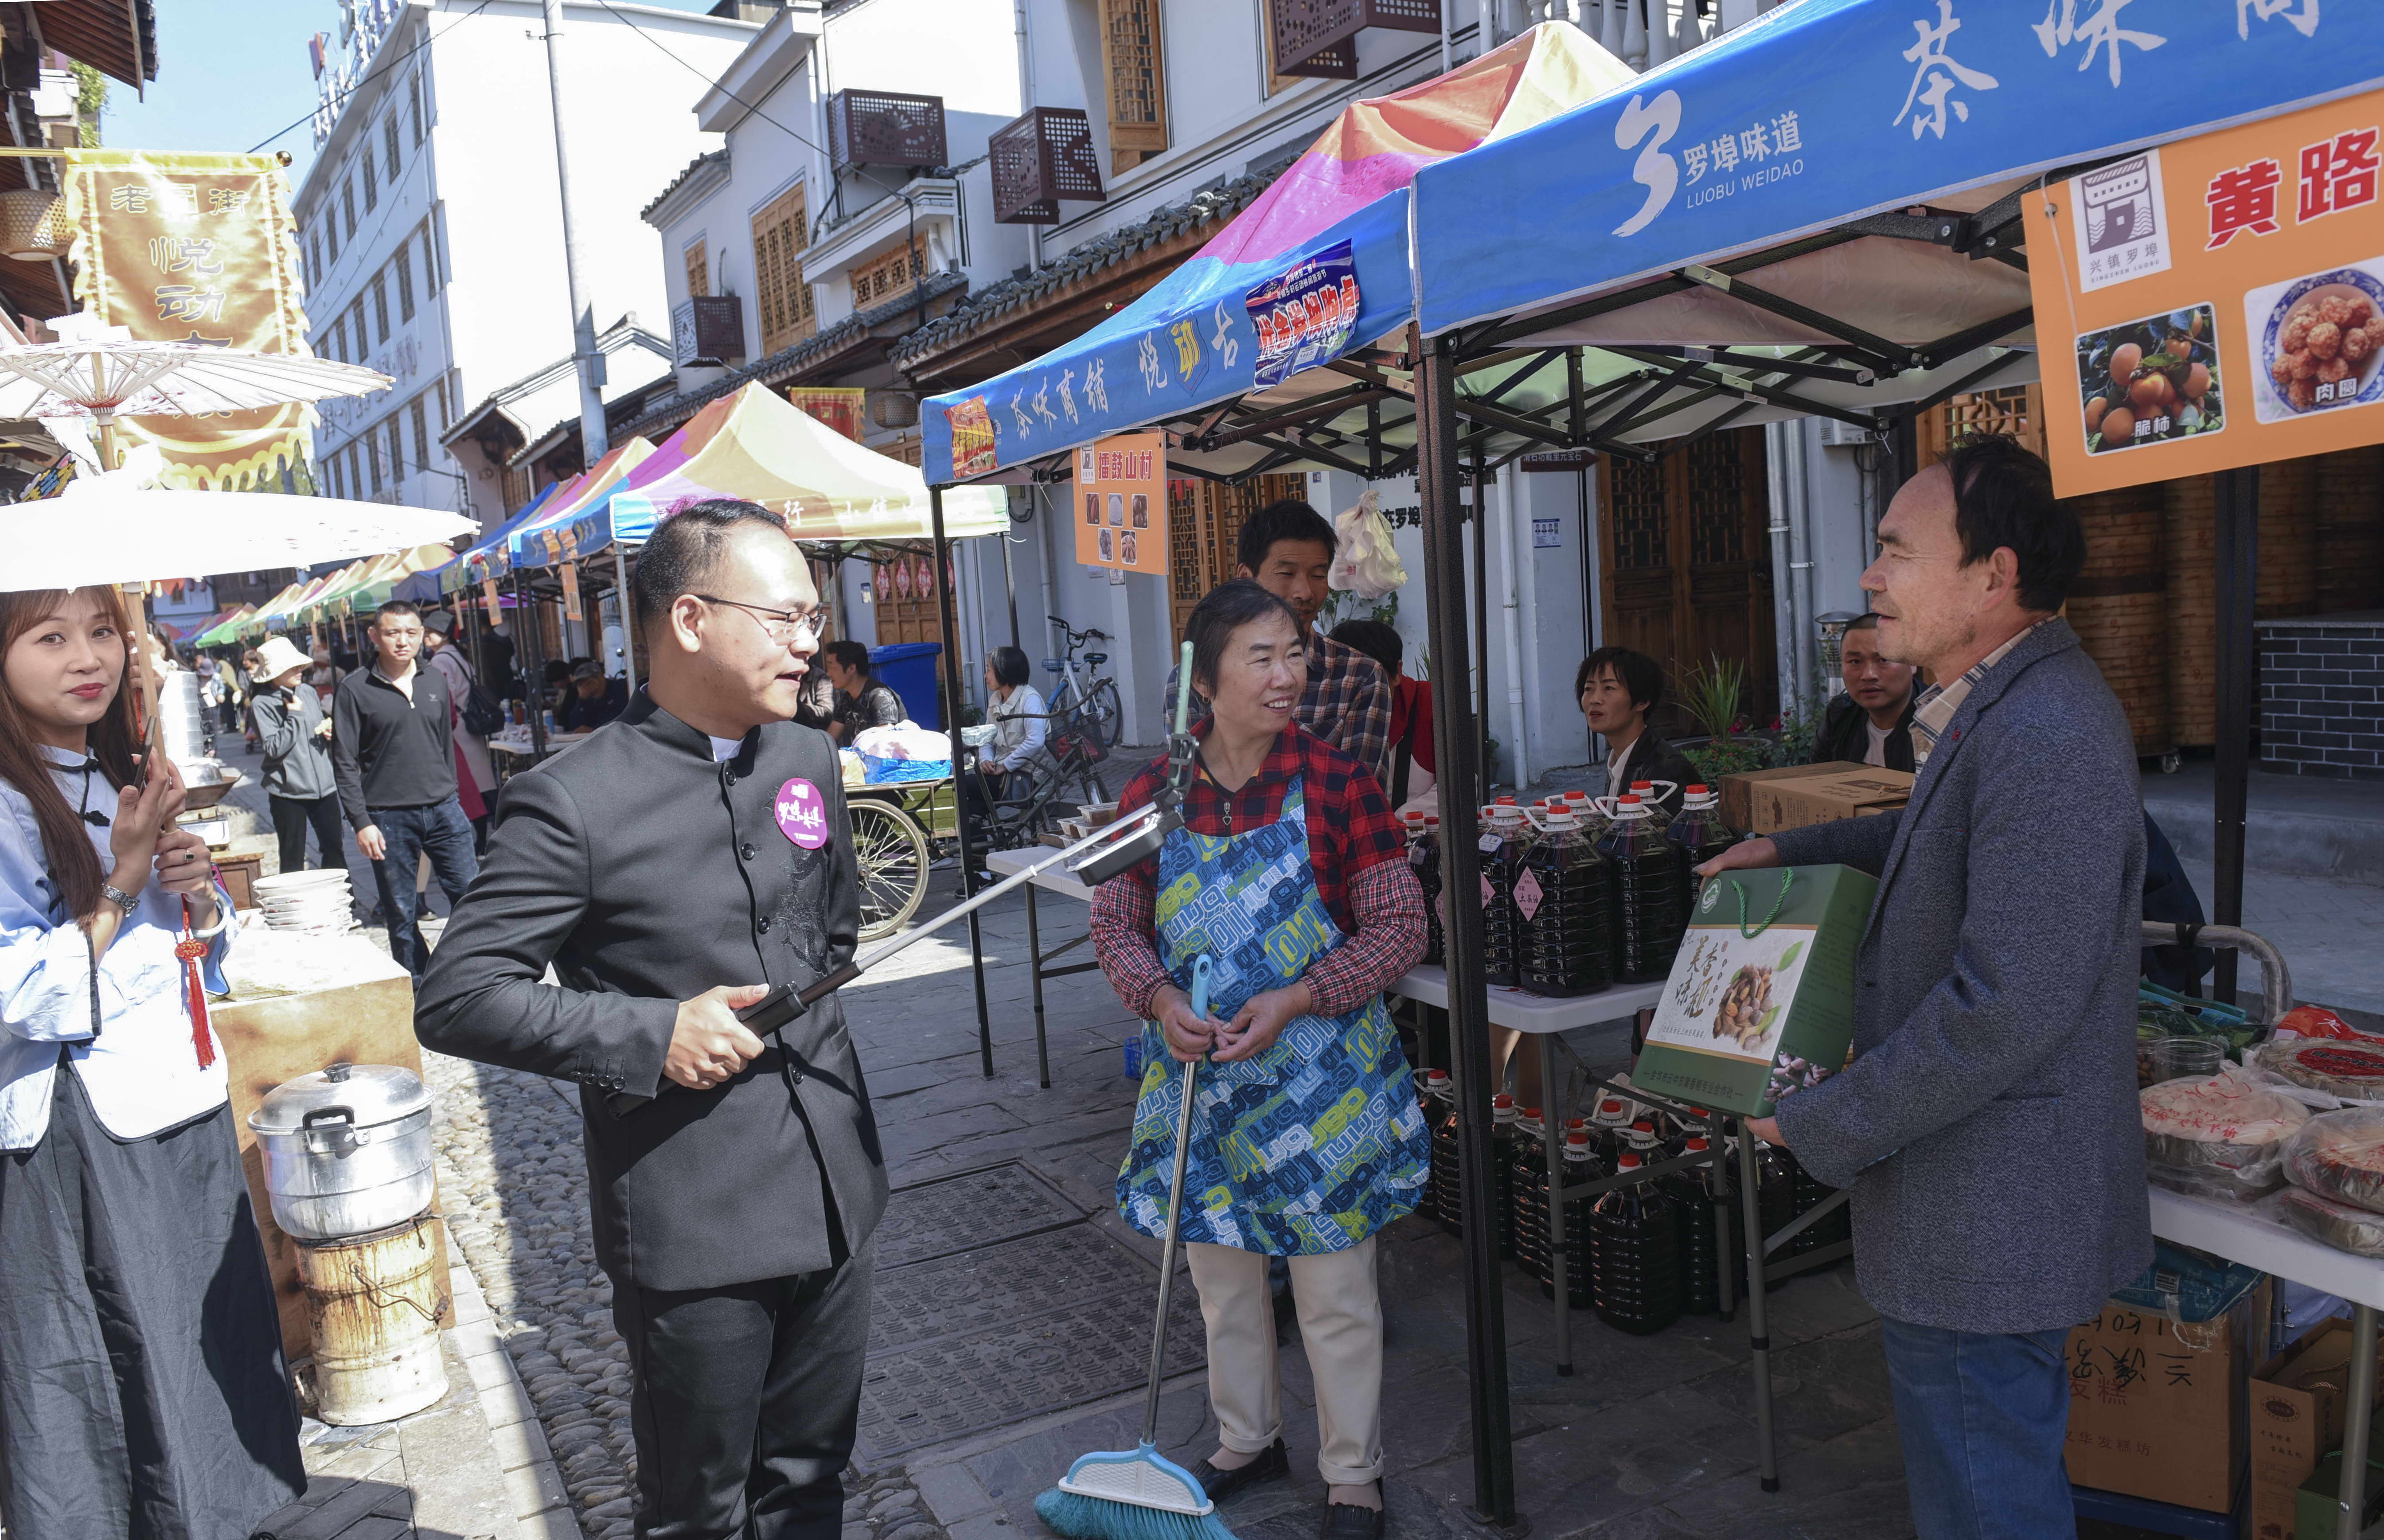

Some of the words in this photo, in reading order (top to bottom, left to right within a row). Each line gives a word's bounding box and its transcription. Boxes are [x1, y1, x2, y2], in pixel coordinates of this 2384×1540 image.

[1683, 110, 1803, 187] 罗埠味道
[1687, 180, 1735, 209] LUOBU
[1742, 159, 1804, 191] WEIDAO
[2205, 125, 2382, 252] 黄路
[2089, 242, 2159, 273] 兴镇罗埠
[2091, 268, 2130, 283] XINGZHEN
[2134, 259, 2160, 271] LUOBU
[1011, 357, 1108, 440] 茶味商铺
[2316, 378, 2358, 403] 肉圆
[2134, 415, 2170, 437] 脆柿
[1097, 450, 1153, 481] 擂鼓山村
